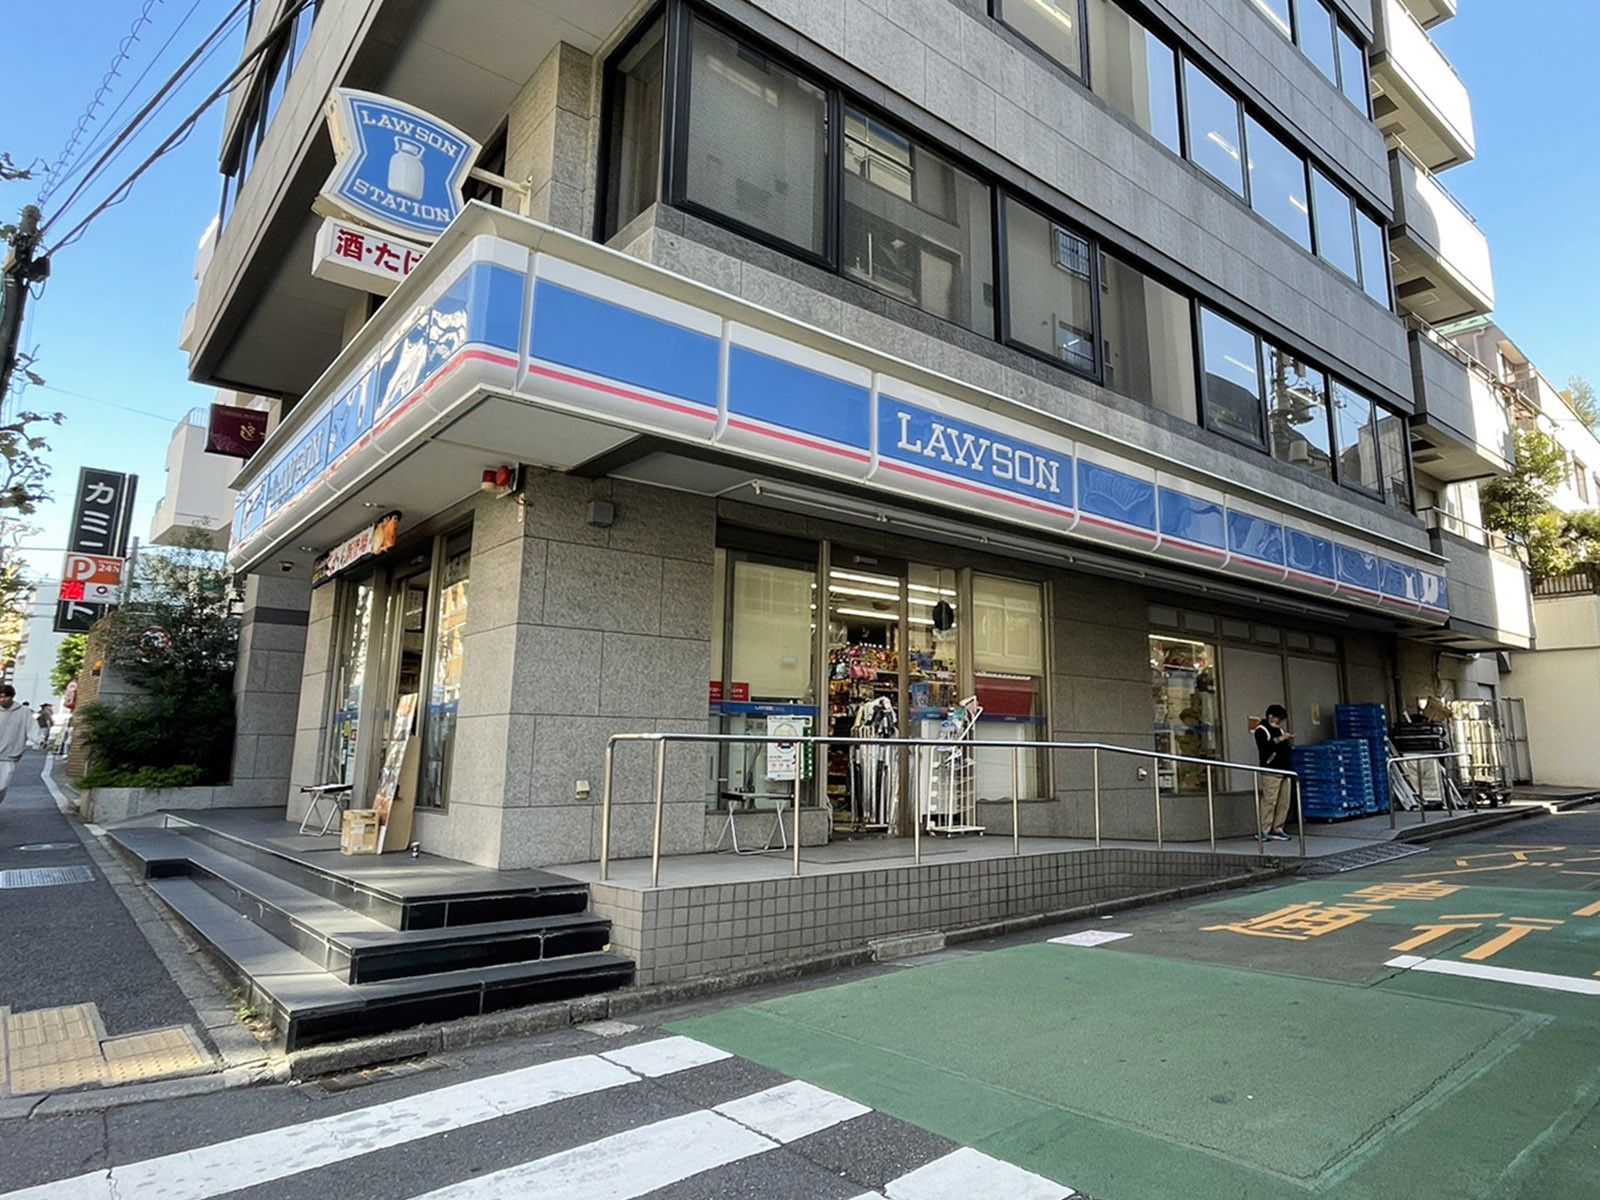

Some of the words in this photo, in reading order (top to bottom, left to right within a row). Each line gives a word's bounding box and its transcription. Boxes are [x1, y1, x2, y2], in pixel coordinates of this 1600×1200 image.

[360, 110, 459, 158] LAWSON
[352, 178, 452, 222] STATION
[897, 411, 1060, 494] LAWSON
